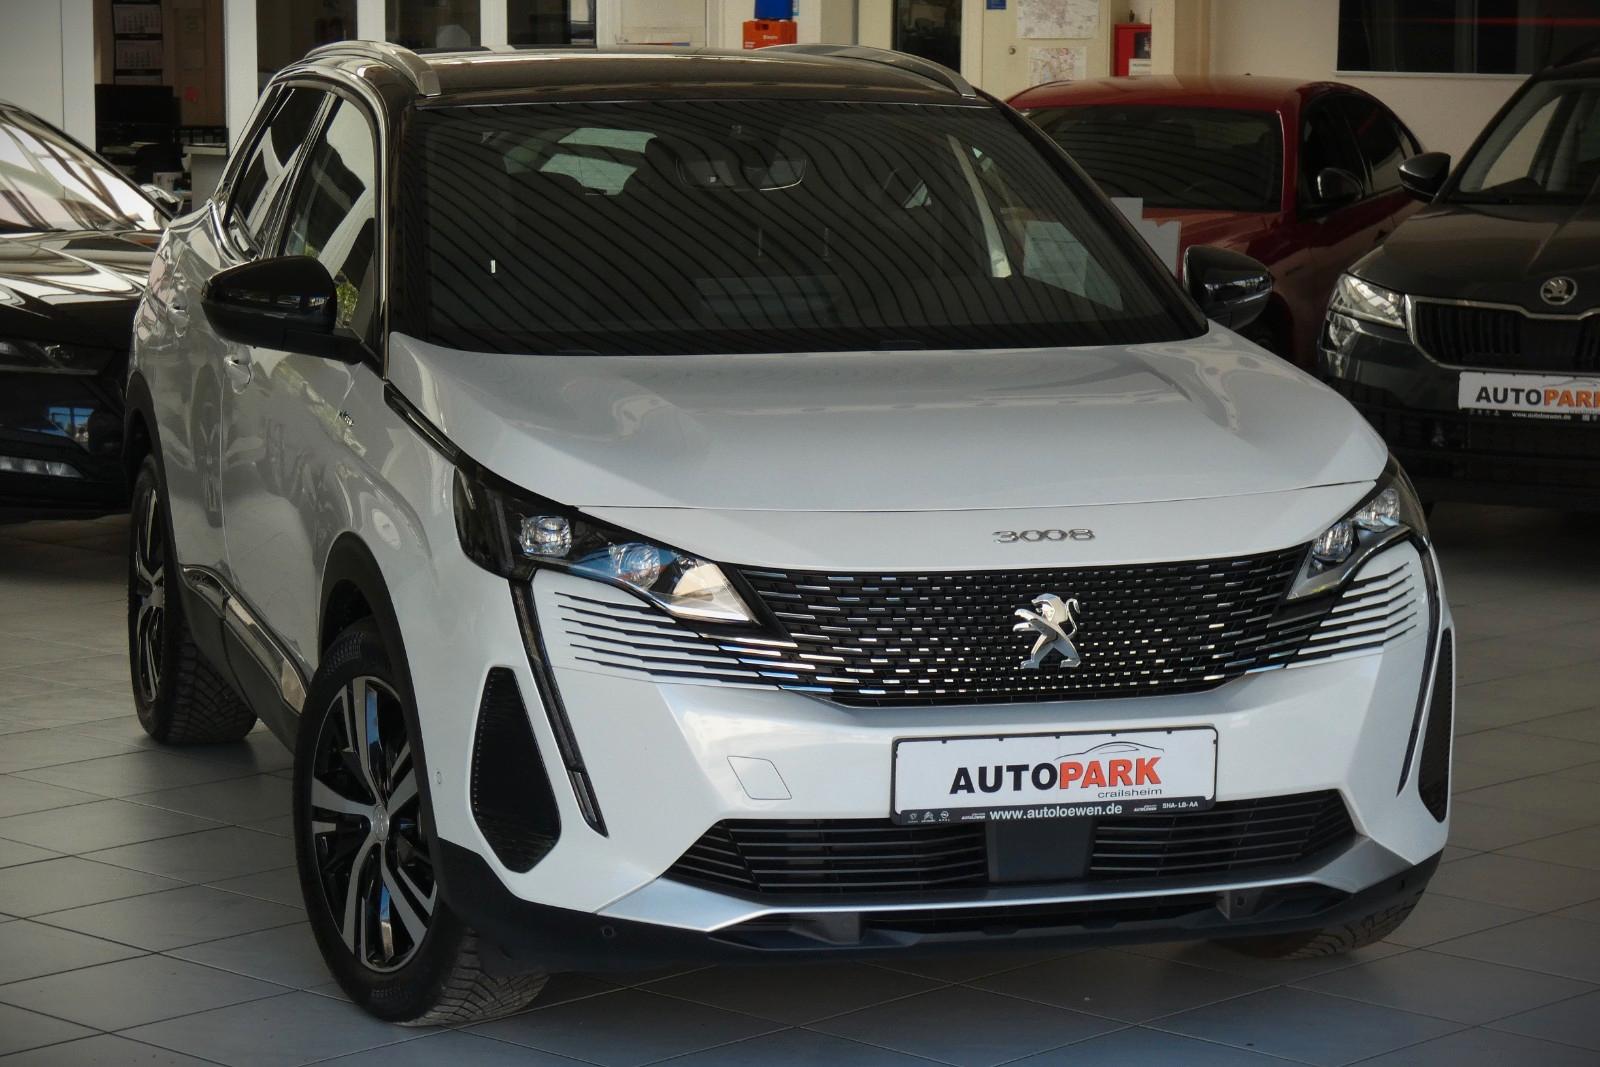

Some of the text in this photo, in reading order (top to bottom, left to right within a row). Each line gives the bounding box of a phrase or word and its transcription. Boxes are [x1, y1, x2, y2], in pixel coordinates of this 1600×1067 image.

[992, 528, 1096, 543] 3008
[949, 756, 1162, 795] AUTOPARK
[1097, 787, 1163, 799] crailsheim
[989, 804, 1123, 821] www.autoloewen.de
